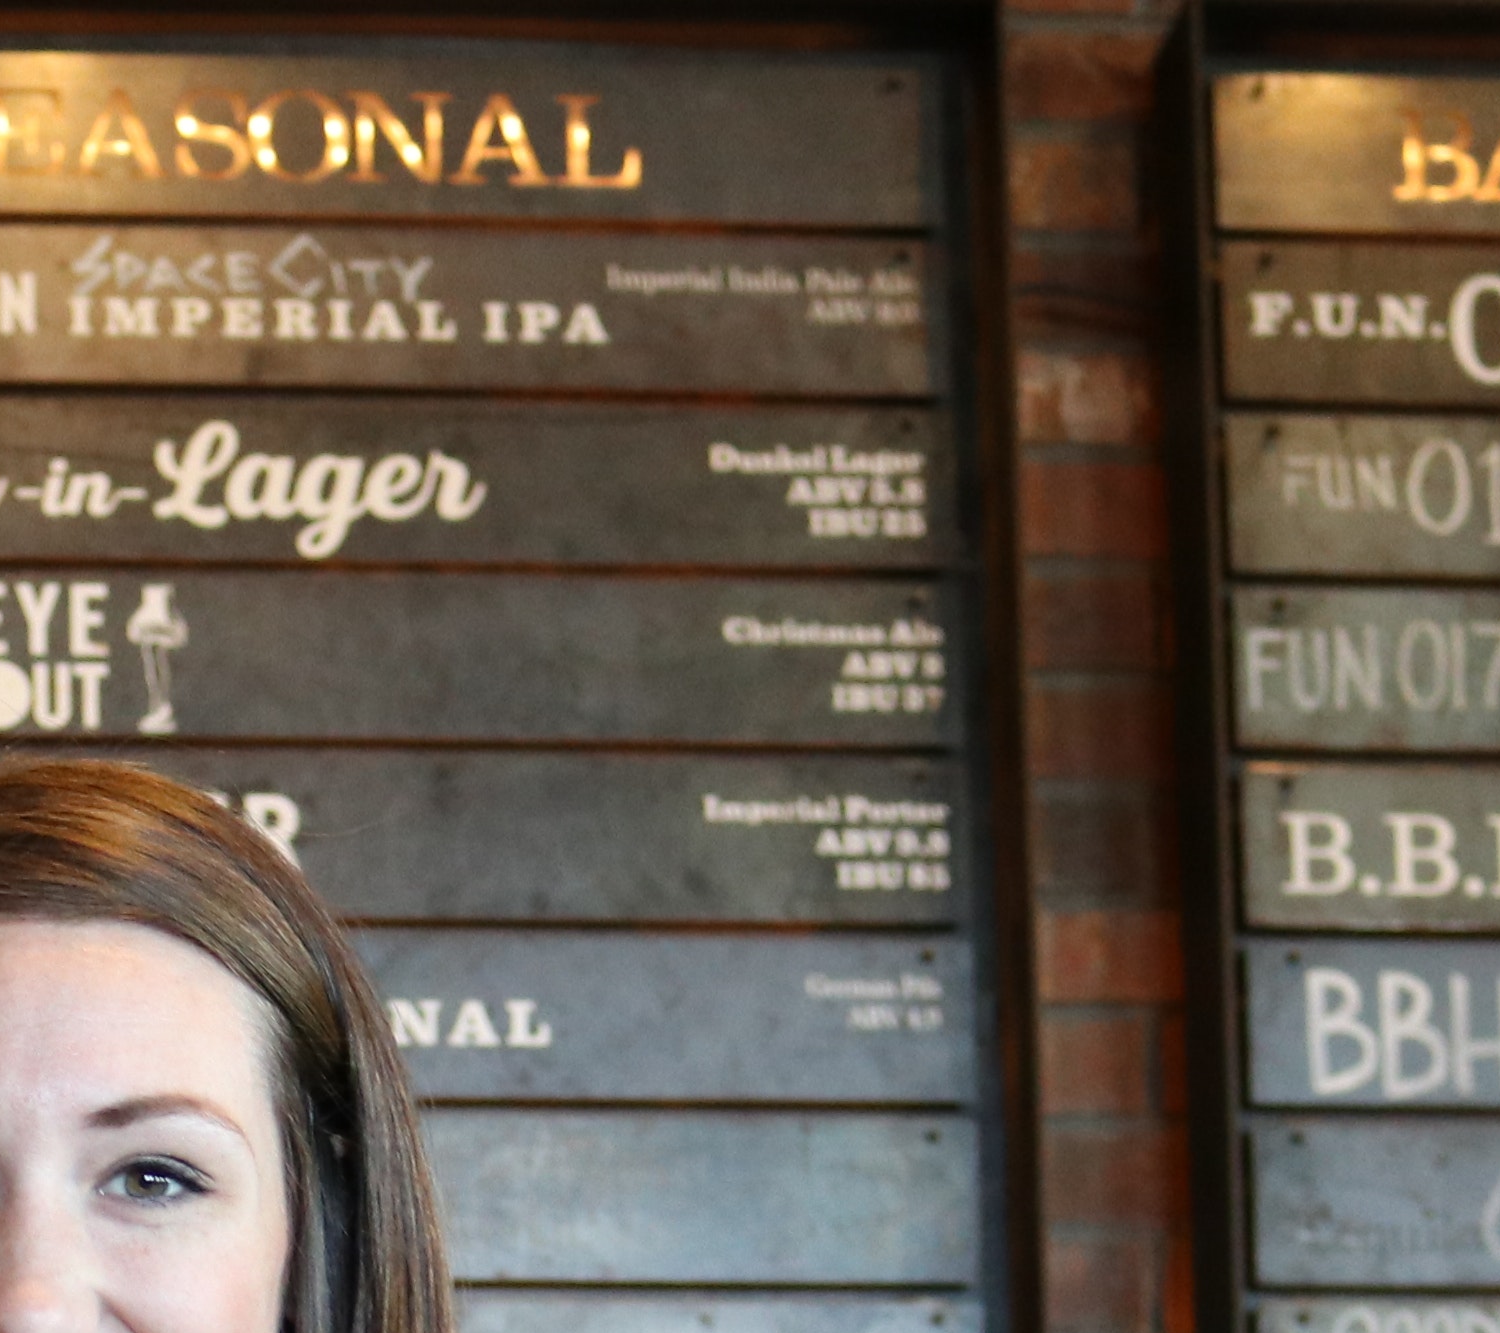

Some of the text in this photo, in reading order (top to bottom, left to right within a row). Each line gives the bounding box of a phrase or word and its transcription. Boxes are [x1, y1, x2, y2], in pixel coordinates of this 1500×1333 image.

[68, 296, 612, 346] IMPERIAL IPA
[1281, 453, 1398, 511] FUN
[1241, 624, 1384, 715] FUN
